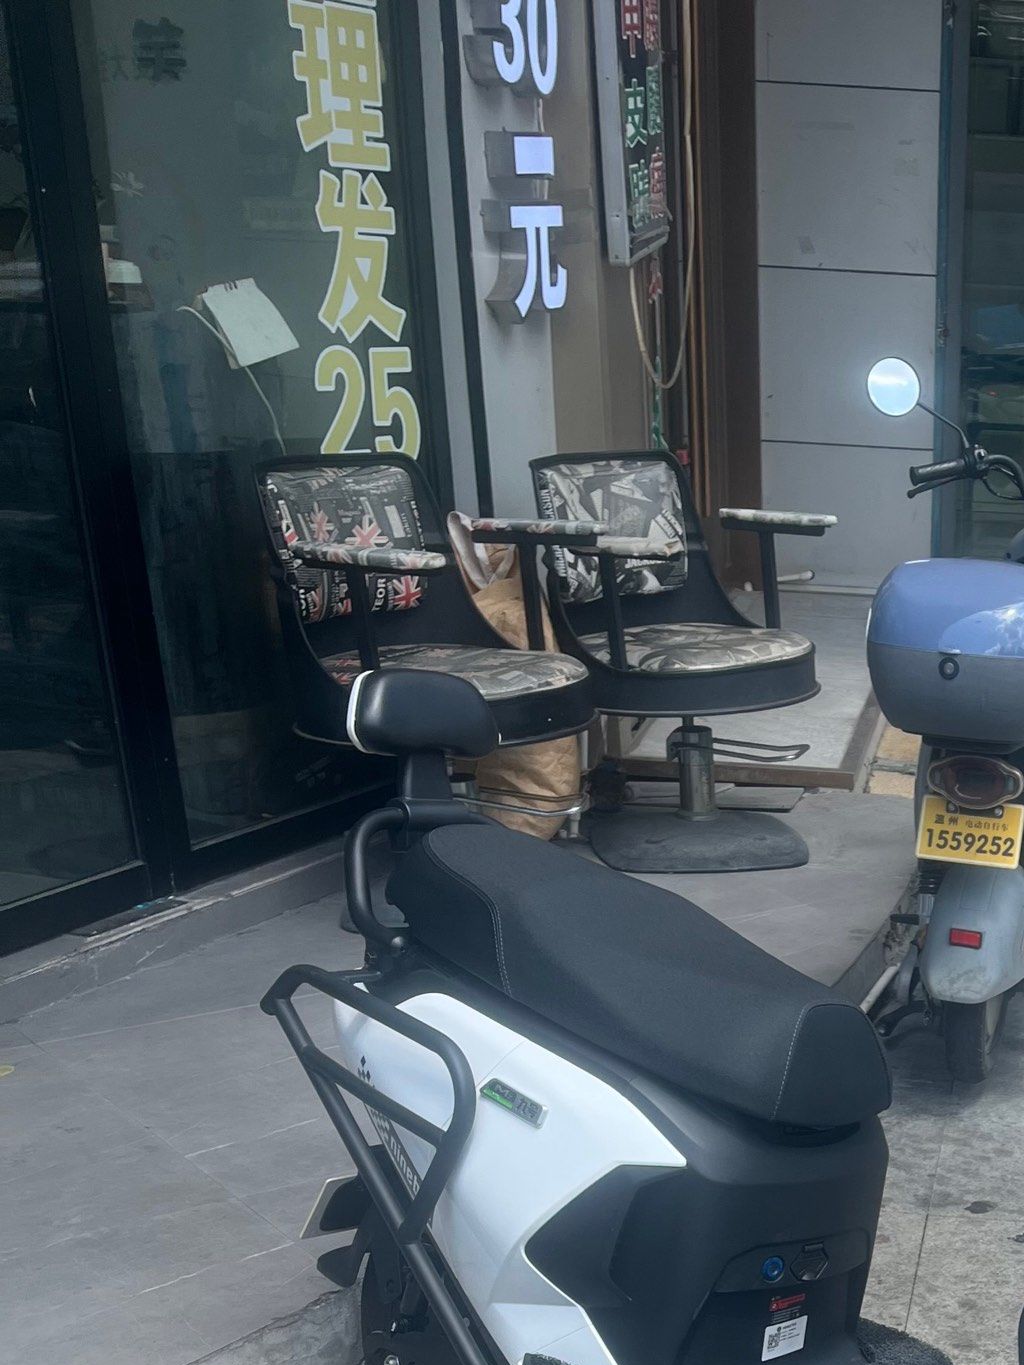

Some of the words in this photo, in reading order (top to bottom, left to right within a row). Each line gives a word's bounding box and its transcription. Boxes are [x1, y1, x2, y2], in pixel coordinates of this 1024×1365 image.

[493, 0, 557, 96] 30
[510, 204, 568, 318] 元
[314, 345, 421, 461] 25
[926, 828, 1016, 858] 1559252
